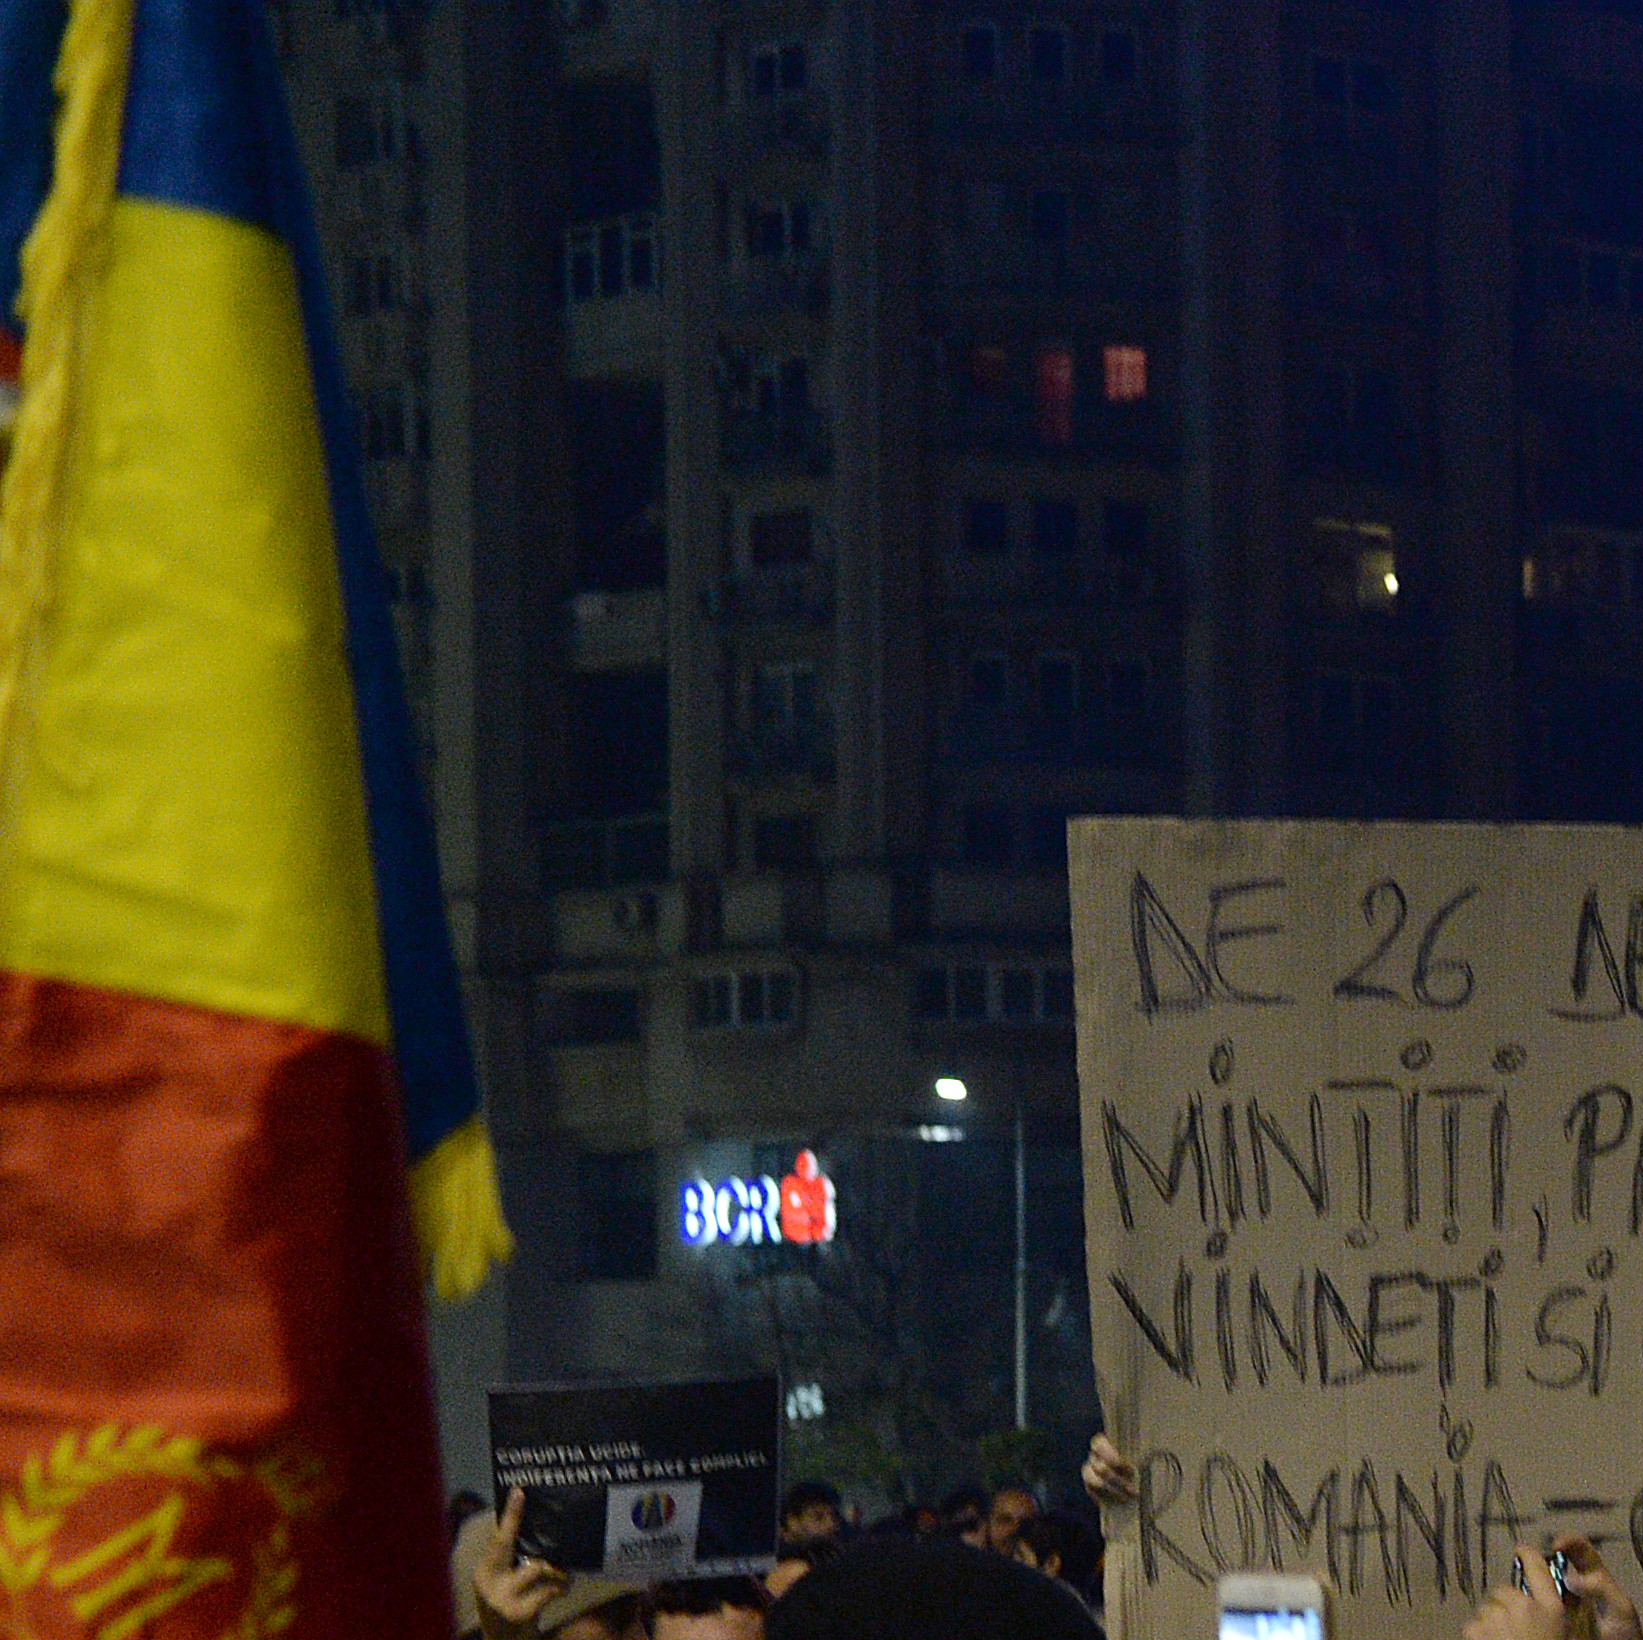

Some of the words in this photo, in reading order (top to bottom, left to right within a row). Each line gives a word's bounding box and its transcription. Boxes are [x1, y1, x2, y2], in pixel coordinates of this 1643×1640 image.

[1131, 868, 1294, 1023] DE
[1334, 876, 1482, 1010] 26
[679, 1174, 782, 1248] BCR
[1526, 1246, 1617, 1397] SI
